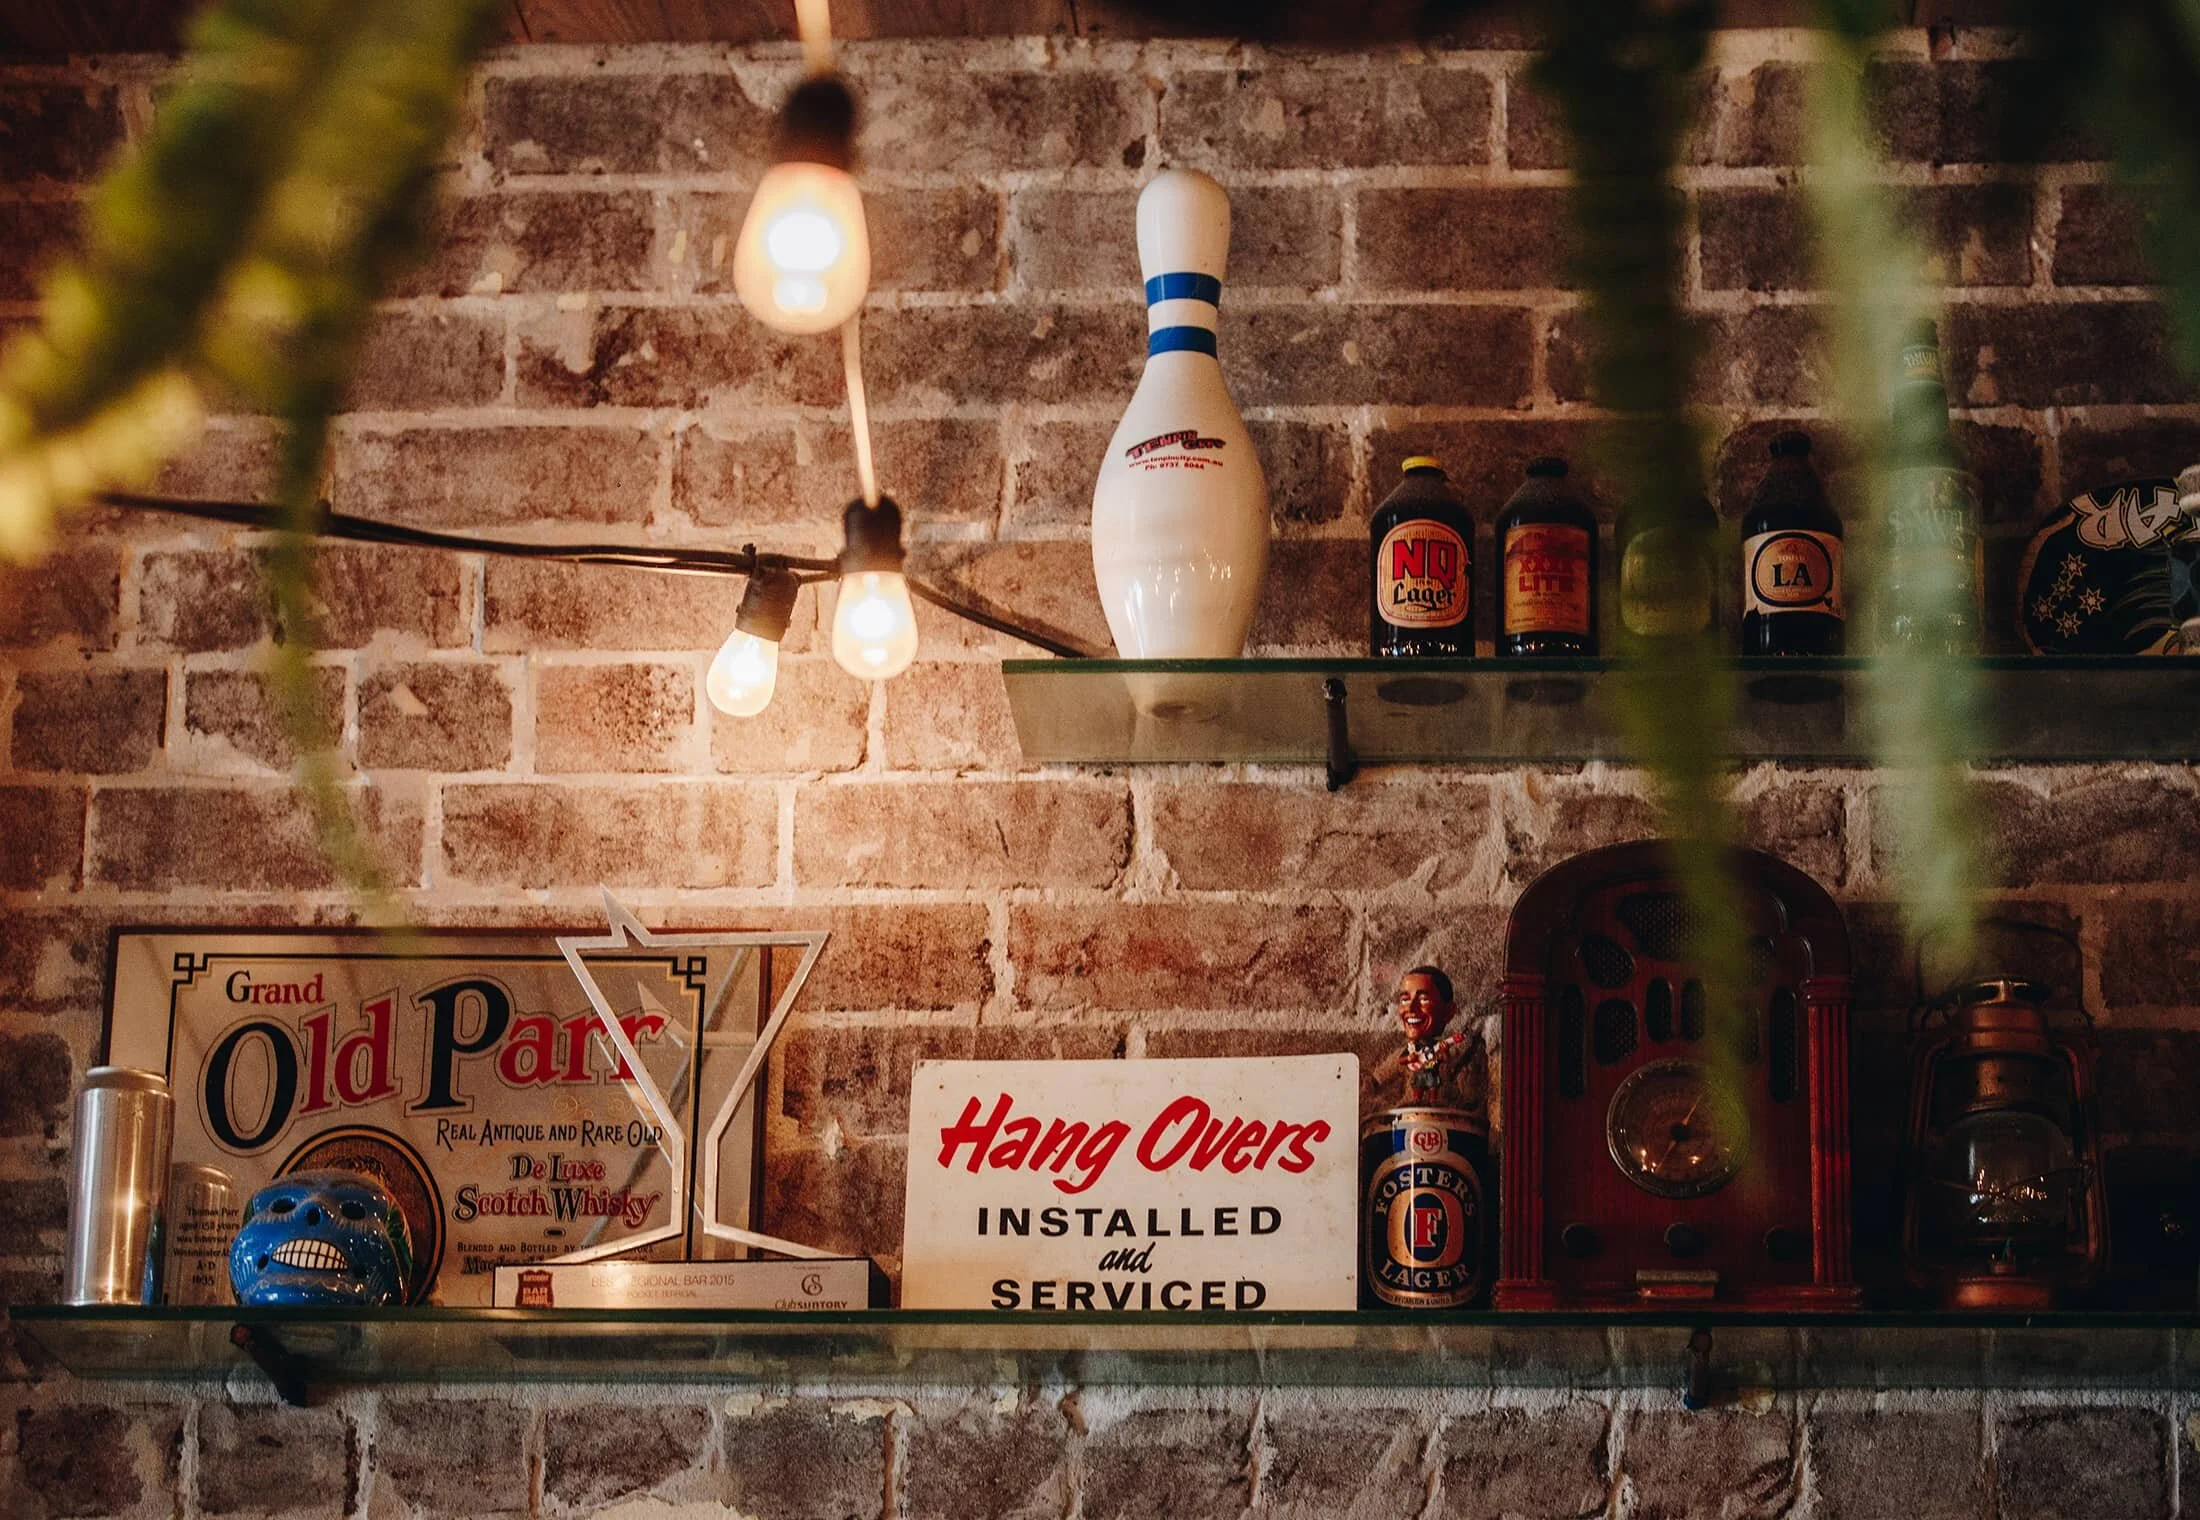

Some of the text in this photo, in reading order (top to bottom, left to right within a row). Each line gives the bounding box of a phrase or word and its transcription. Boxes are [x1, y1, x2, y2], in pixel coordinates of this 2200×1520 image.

[1392, 538, 1457, 589] NQ
[1771, 562, 1813, 587] LA
[1392, 582, 1457, 610] Lager
[225, 969, 325, 1005] Grand
[200, 977, 669, 1152] Old Parr
[436, 1118, 663, 1151] REAL ANTIQUE AND RARE OLD
[937, 1092, 1331, 1195] Hang Overs
[509, 1152, 606, 1183] De Luxe
[452, 1183, 662, 1228] Scotch Whisky
[977, 1206, 1282, 1237] INSTALLED
[1413, 1207, 1443, 1248] F
[1098, 1241, 1156, 1273] and
[1379, 1257, 1471, 1289] LAGER
[623, 1275, 678, 1287] EGIONAL
[683, 1274, 707, 1287] BAR
[991, 1278, 1267, 1311] SERVICED
